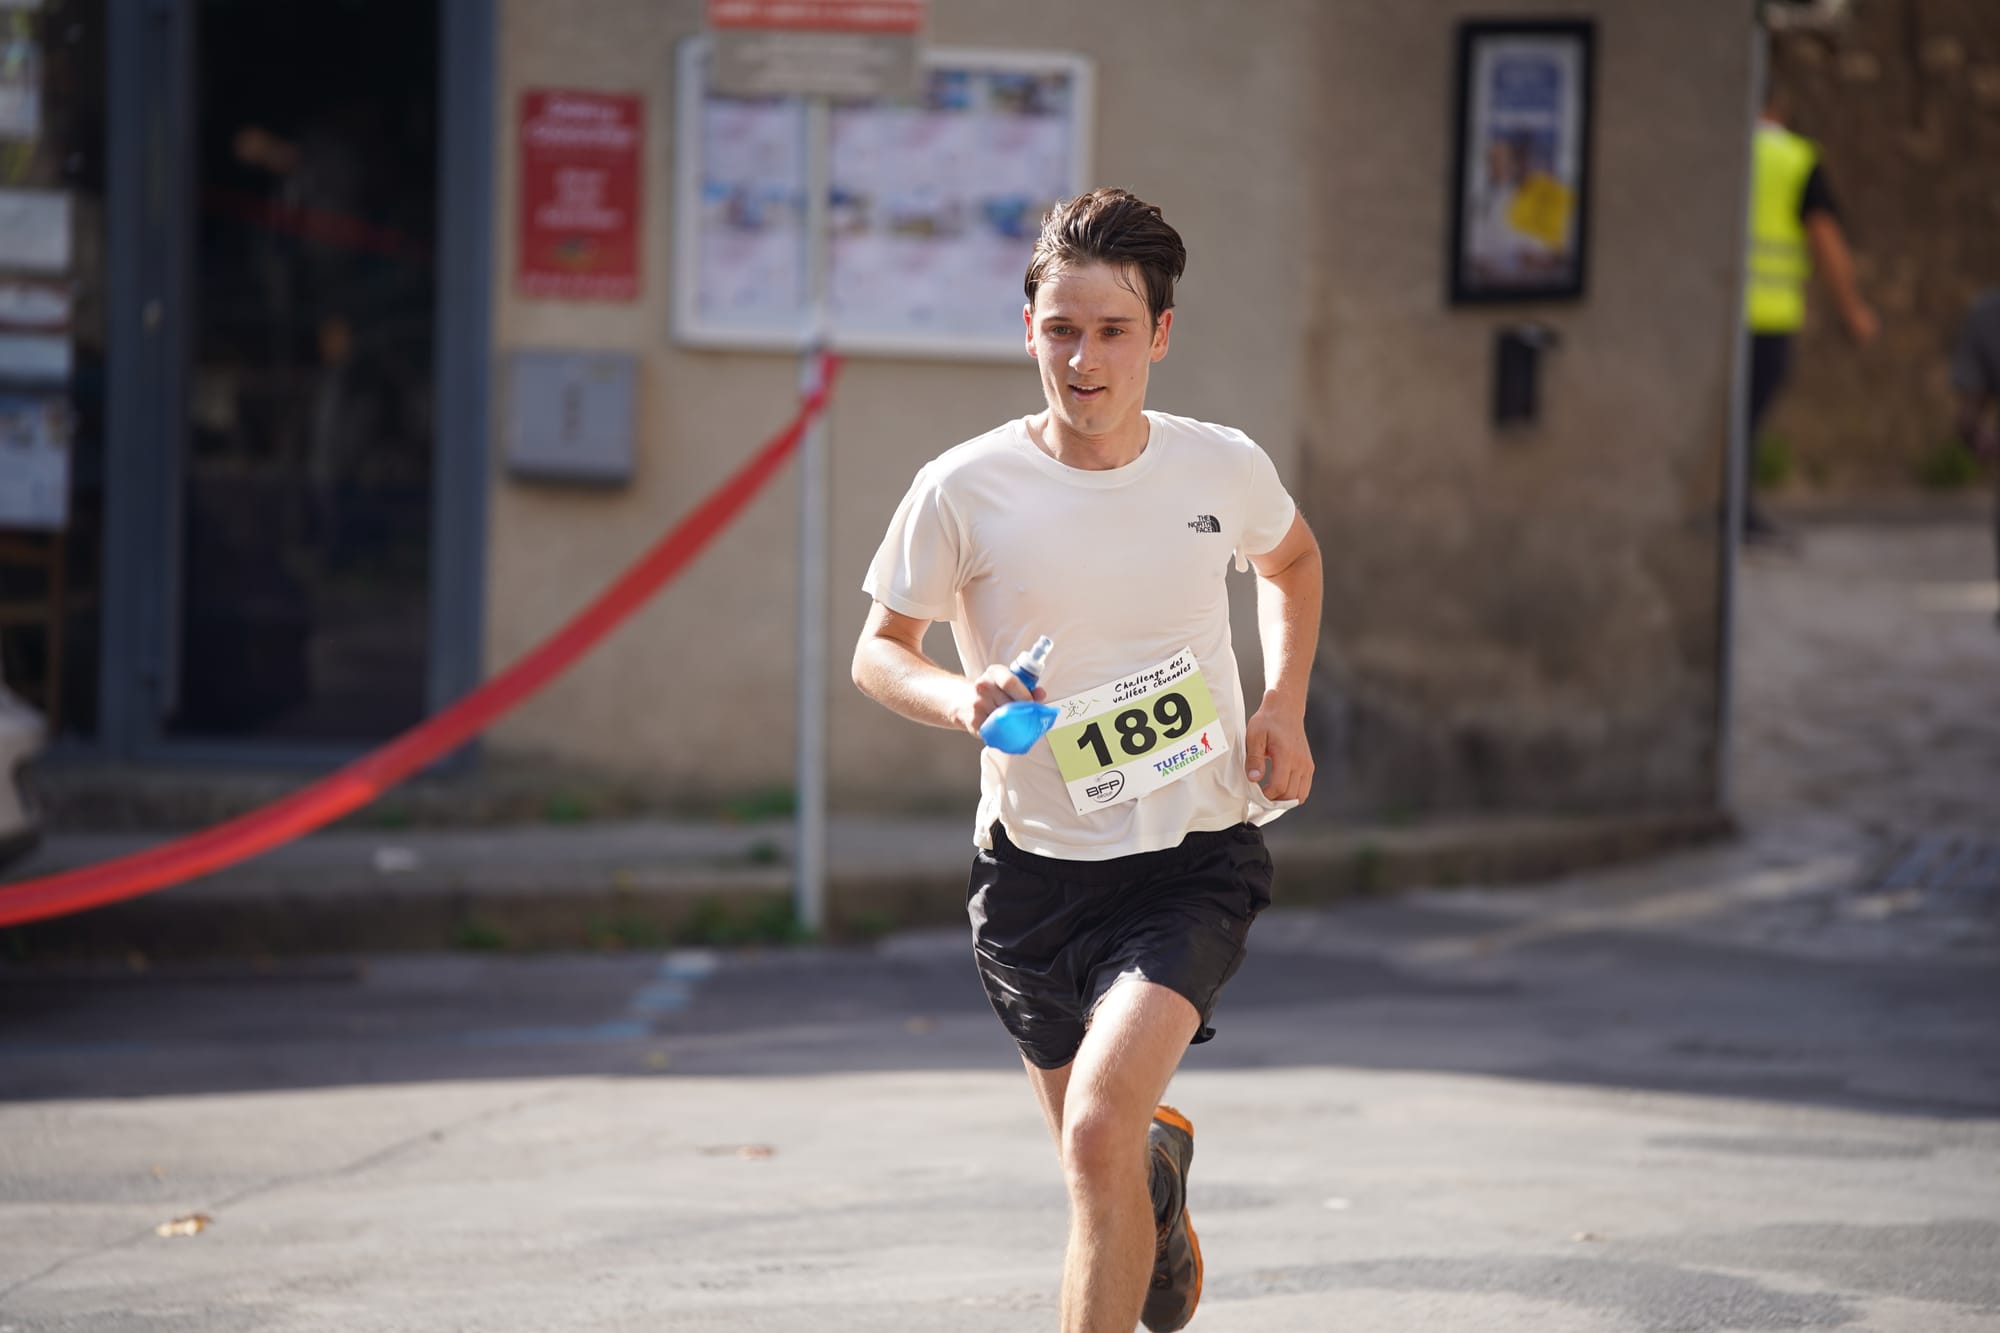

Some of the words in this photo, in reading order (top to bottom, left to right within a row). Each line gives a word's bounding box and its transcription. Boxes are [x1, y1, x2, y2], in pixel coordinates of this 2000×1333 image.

[1112, 685, 1147, 703] vallées
[1153, 663, 1191, 688] cévenoles
[1114, 669, 1165, 692] Challenge
[1169, 657, 1184, 670] des
[1076, 692, 1193, 767] 189
[1153, 744, 1199, 772] TUFF'S
[1162, 749, 1204, 777] Aventure
[1086, 779, 1120, 798] BFP
